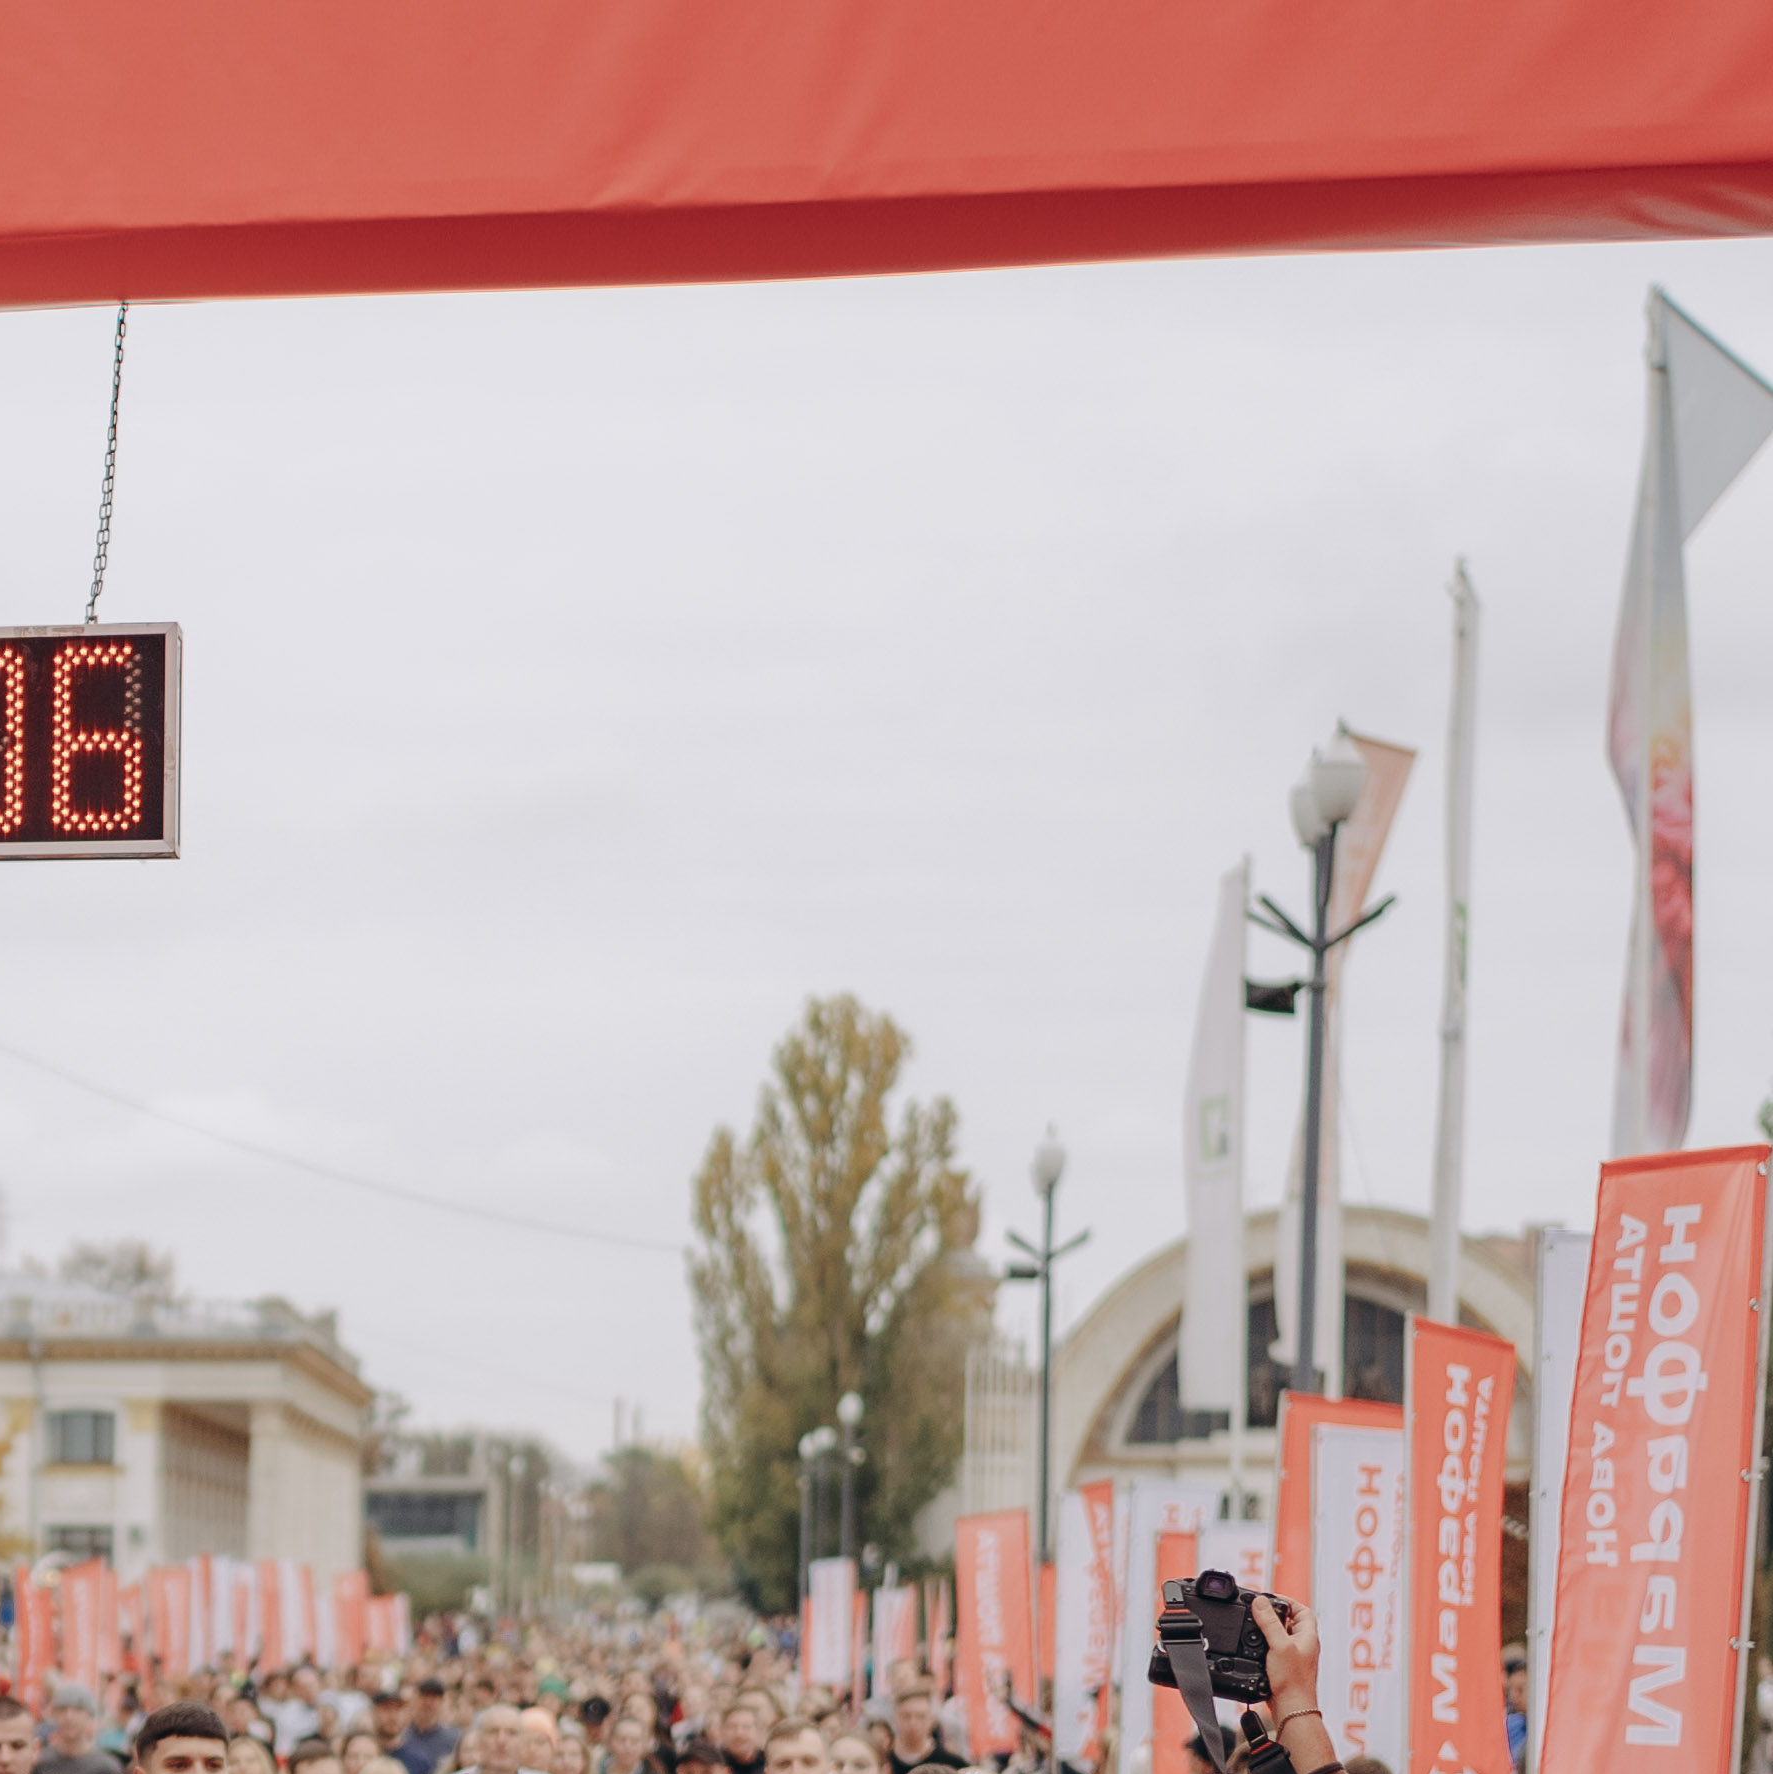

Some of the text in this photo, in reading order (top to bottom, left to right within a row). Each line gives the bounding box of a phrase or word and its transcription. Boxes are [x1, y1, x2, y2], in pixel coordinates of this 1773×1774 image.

[1431, 1362, 1472, 1724] Марафон
[1460, 1375, 1495, 1606] НОВА ПОШТА
